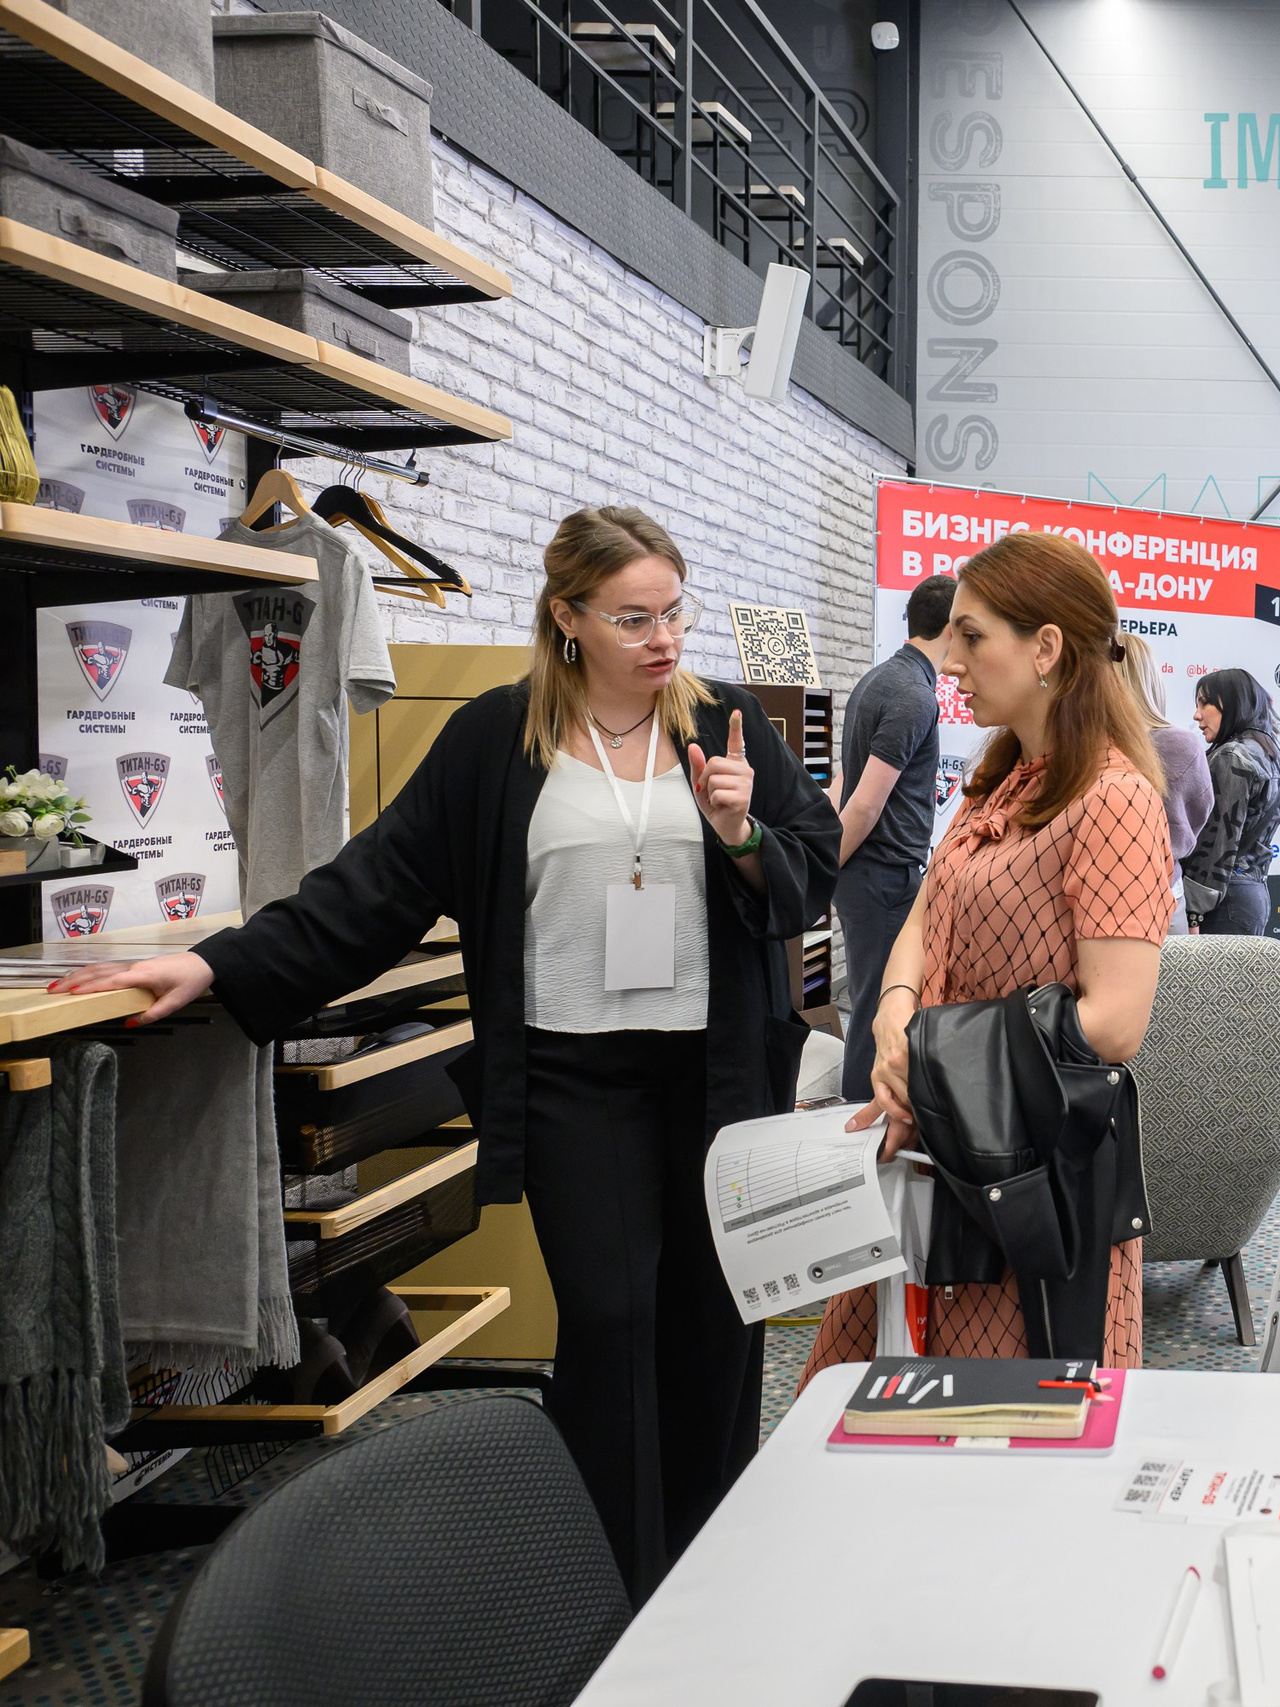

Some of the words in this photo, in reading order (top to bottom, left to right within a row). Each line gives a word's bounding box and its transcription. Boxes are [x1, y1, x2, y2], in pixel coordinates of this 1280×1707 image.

[925, 0, 1004, 489] ESPONS
[80, 443, 145, 466] ГАРДЕРОБНЫЕ
[95, 459, 136, 478] СИСТЕМЫ
[184, 466, 235, 488] ГАРДЕРОБНЫЕ
[38, 483, 79, 506] ТАН-GS
[193, 481, 227, 498] СИСТЕМЫ
[902, 509, 1258, 571] БИЗНЕОНФЕРЕНЦИЯ
[902, 550, 923, 577] В
[141, 598, 179, 611] СИСТЕМЫ
[1120, 619, 1178, 637] ЕРЬЕРА
[66, 710, 136, 722] ГАРДЕРОБНЫЕ
[170, 712, 206, 722] ГАРДЕРО
[79, 724, 126, 734] СИСТЕМЫ
[119, 757, 167, 774] ТИТАН-GS
[113, 835, 173, 850] ГАРДЕРОБНЫЕ
[205, 830, 232, 841] ГАРДЕР
[126, 849, 164, 861] ИСТЕМЫ
[213, 842, 236, 851] СИСТЕ
[158, 877, 202, 896] ТИТАН-GS
[54, 888, 109, 910] ТИТАН-GS
